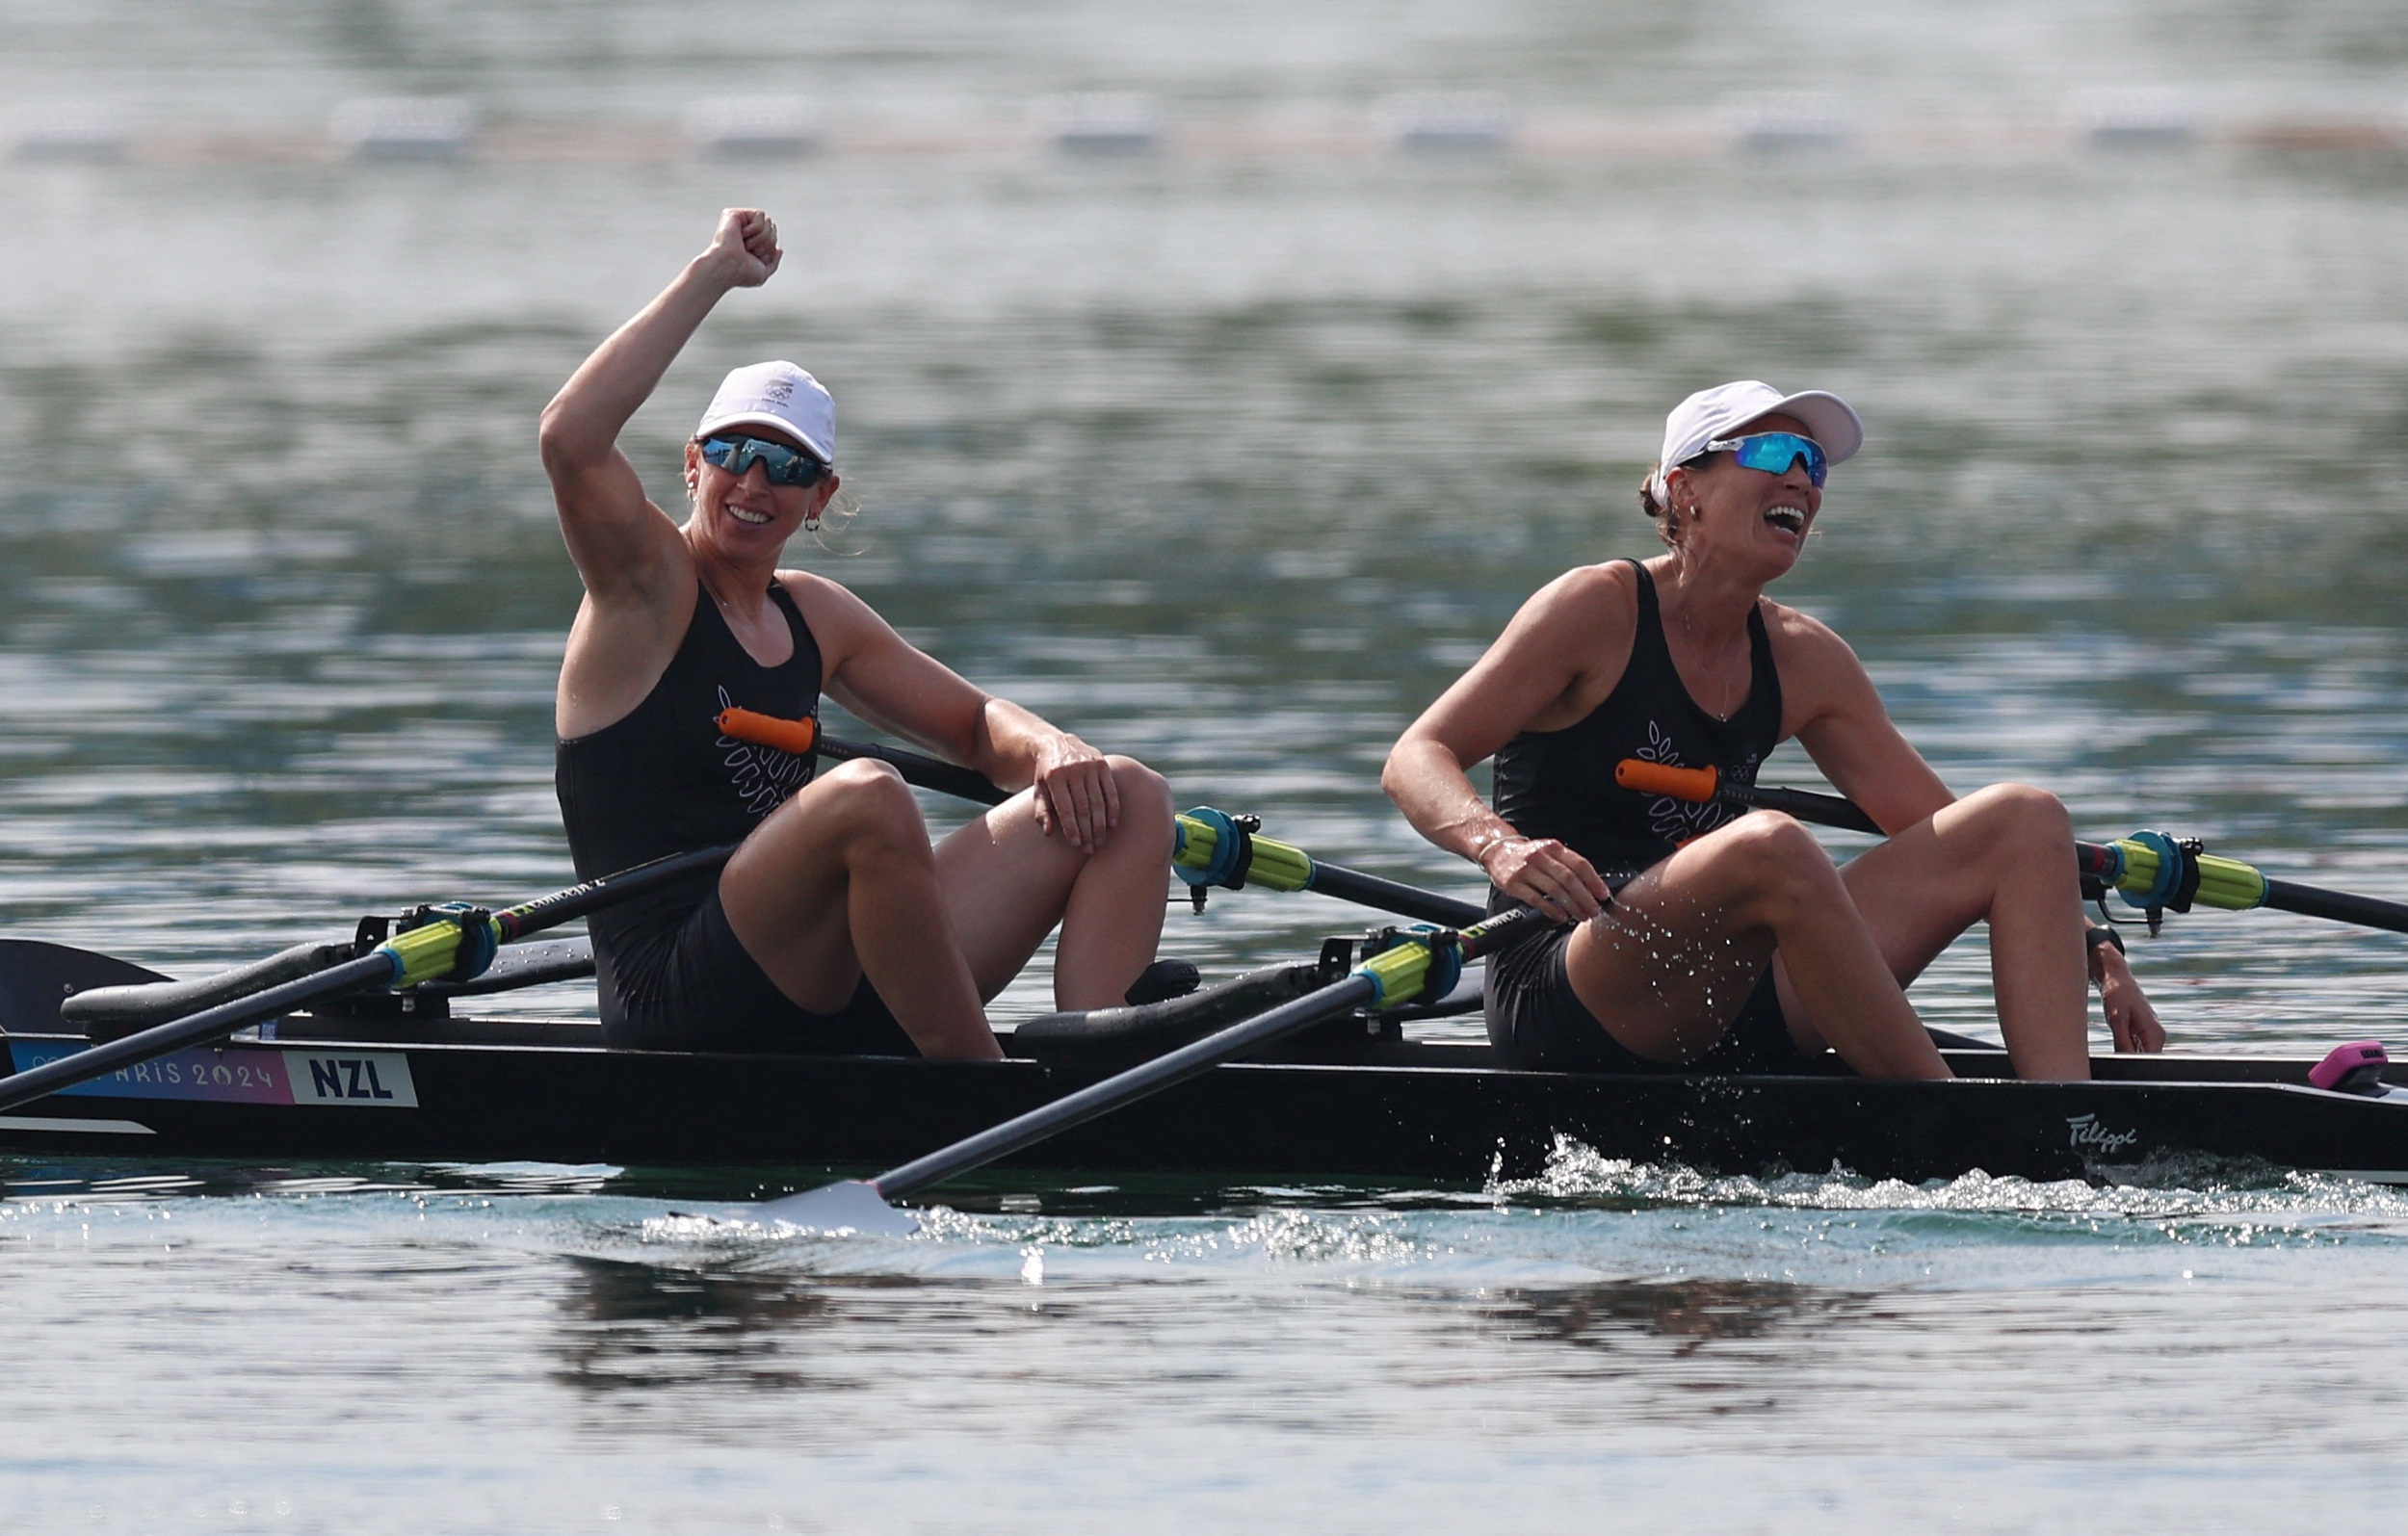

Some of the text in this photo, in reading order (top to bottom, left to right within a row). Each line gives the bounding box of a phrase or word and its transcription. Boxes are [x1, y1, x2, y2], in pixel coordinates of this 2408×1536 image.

[193, 1064, 273, 1088] 2024
[308, 1059, 394, 1099] NZL
[2066, 1112, 2137, 1153] Filippi
